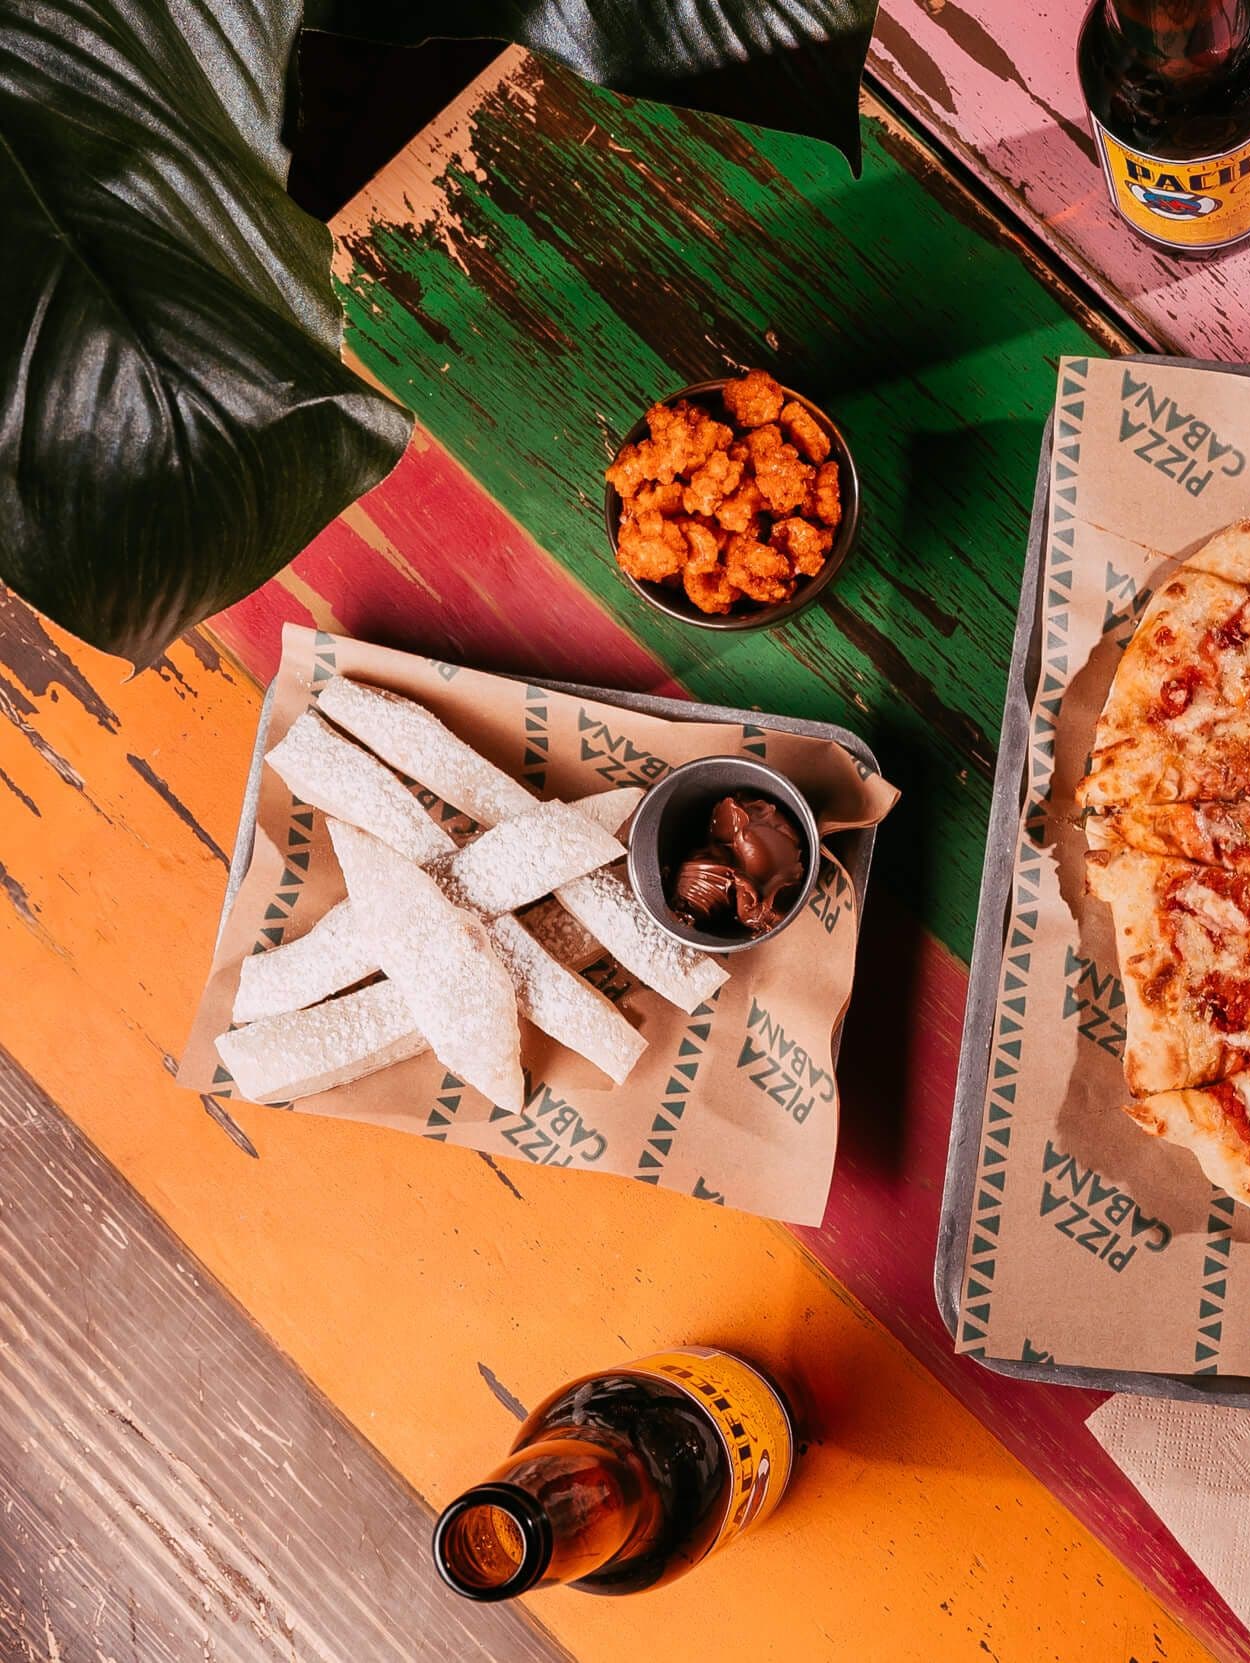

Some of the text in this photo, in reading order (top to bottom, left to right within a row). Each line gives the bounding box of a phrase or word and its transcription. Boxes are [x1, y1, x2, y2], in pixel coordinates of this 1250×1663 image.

[1119, 408, 1213, 497] PIZZA
[1120, 370, 1246, 478] CABANA
[578, 708, 674, 780] BANA
[736, 1035, 818, 1125] PIZZA
[746, 998, 835, 1104] CABANA
[1039, 1181, 1138, 1274] PIZZA
[1043, 1140, 1172, 1254] CABANA
